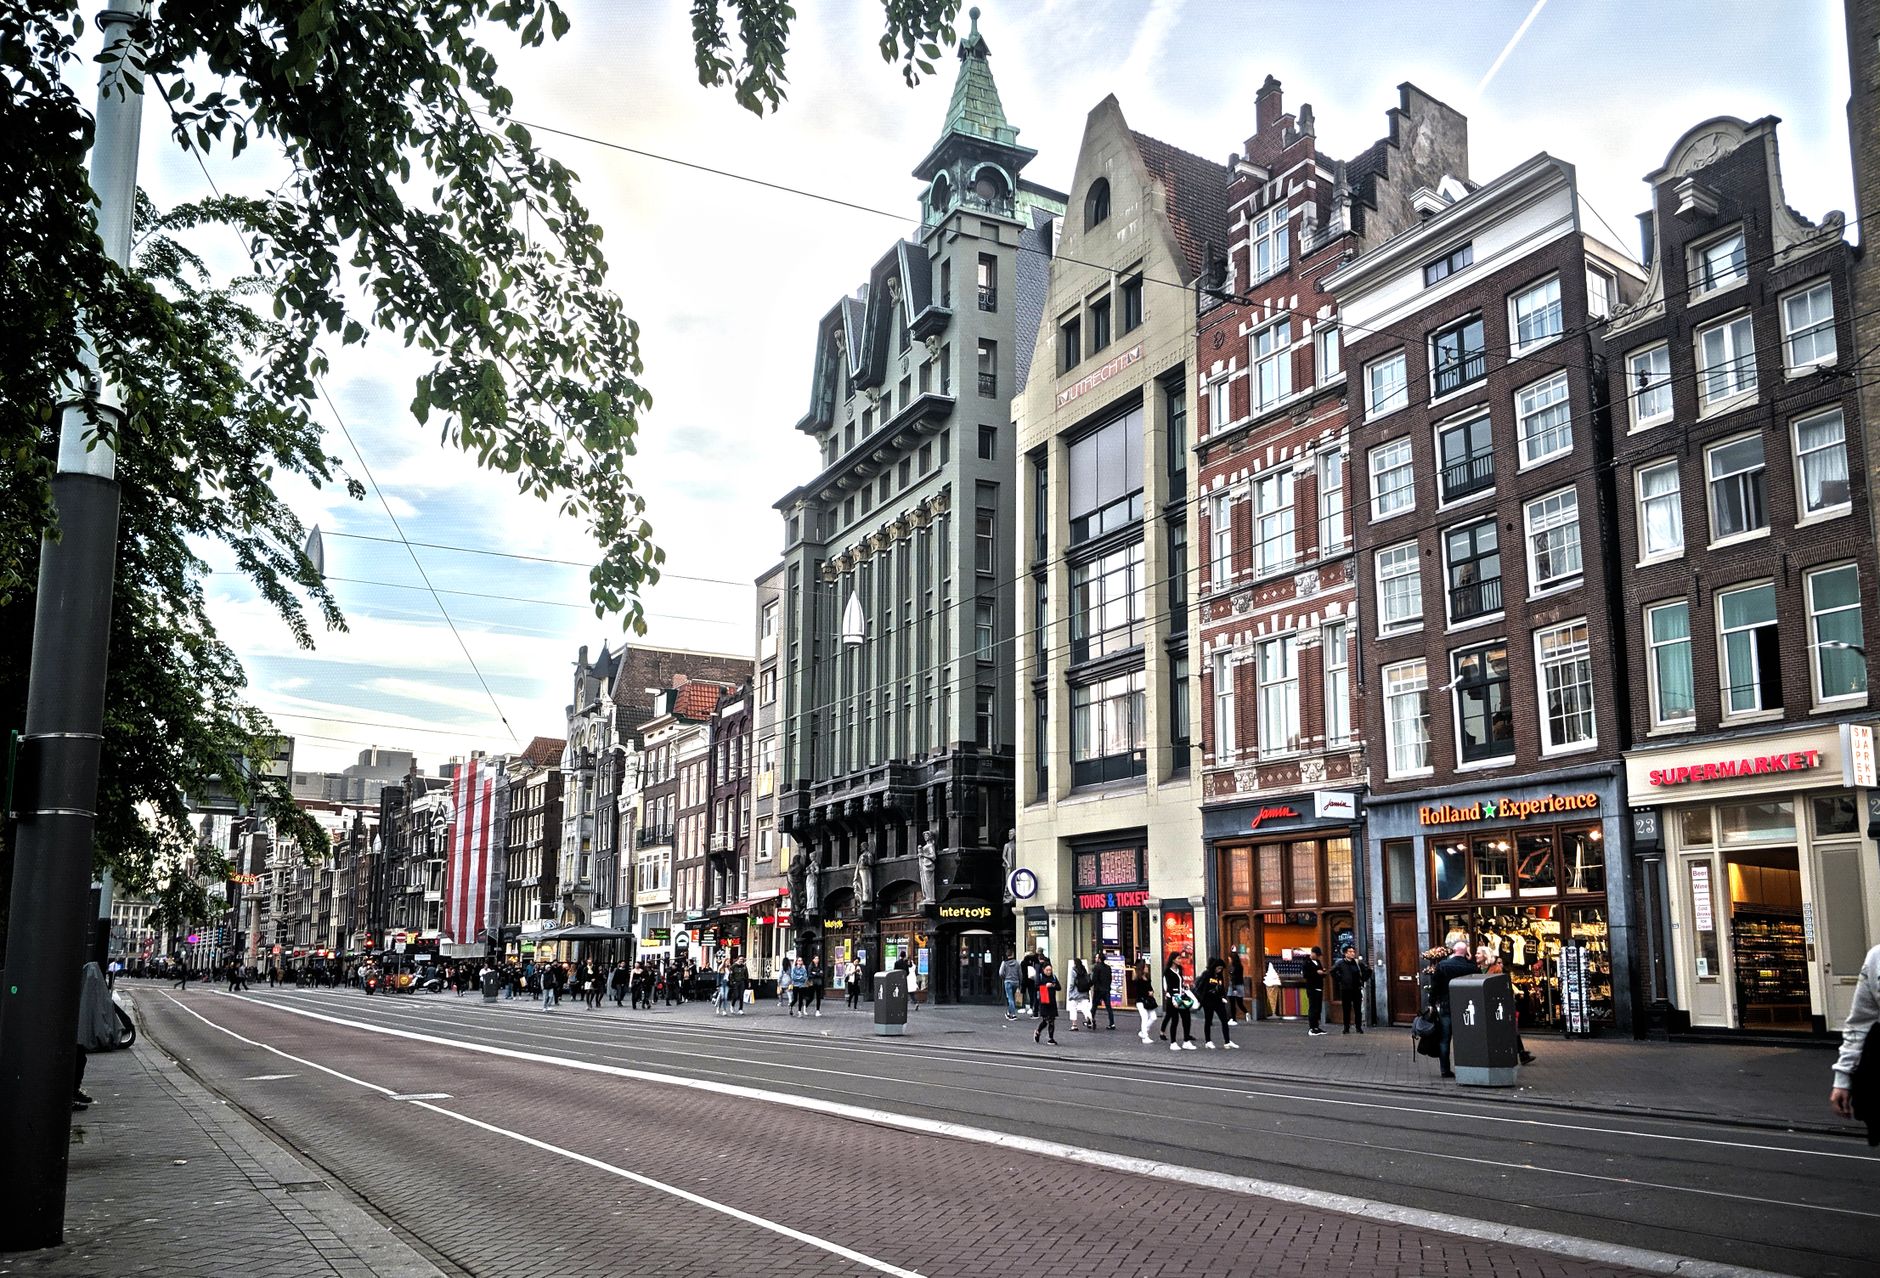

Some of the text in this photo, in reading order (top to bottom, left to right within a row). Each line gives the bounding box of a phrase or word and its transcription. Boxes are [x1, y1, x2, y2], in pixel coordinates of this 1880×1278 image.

[1070, 353, 1125, 400] UTRECHT
[1650, 750, 1819, 786] SUPERMARKET
[1419, 793, 1597, 825] Holland Experience
[1636, 818, 1654, 834] 23
[940, 906, 992, 919] Intertoys
[1079, 893, 1106, 909] TOURS
[1107, 891, 1115, 907] &
